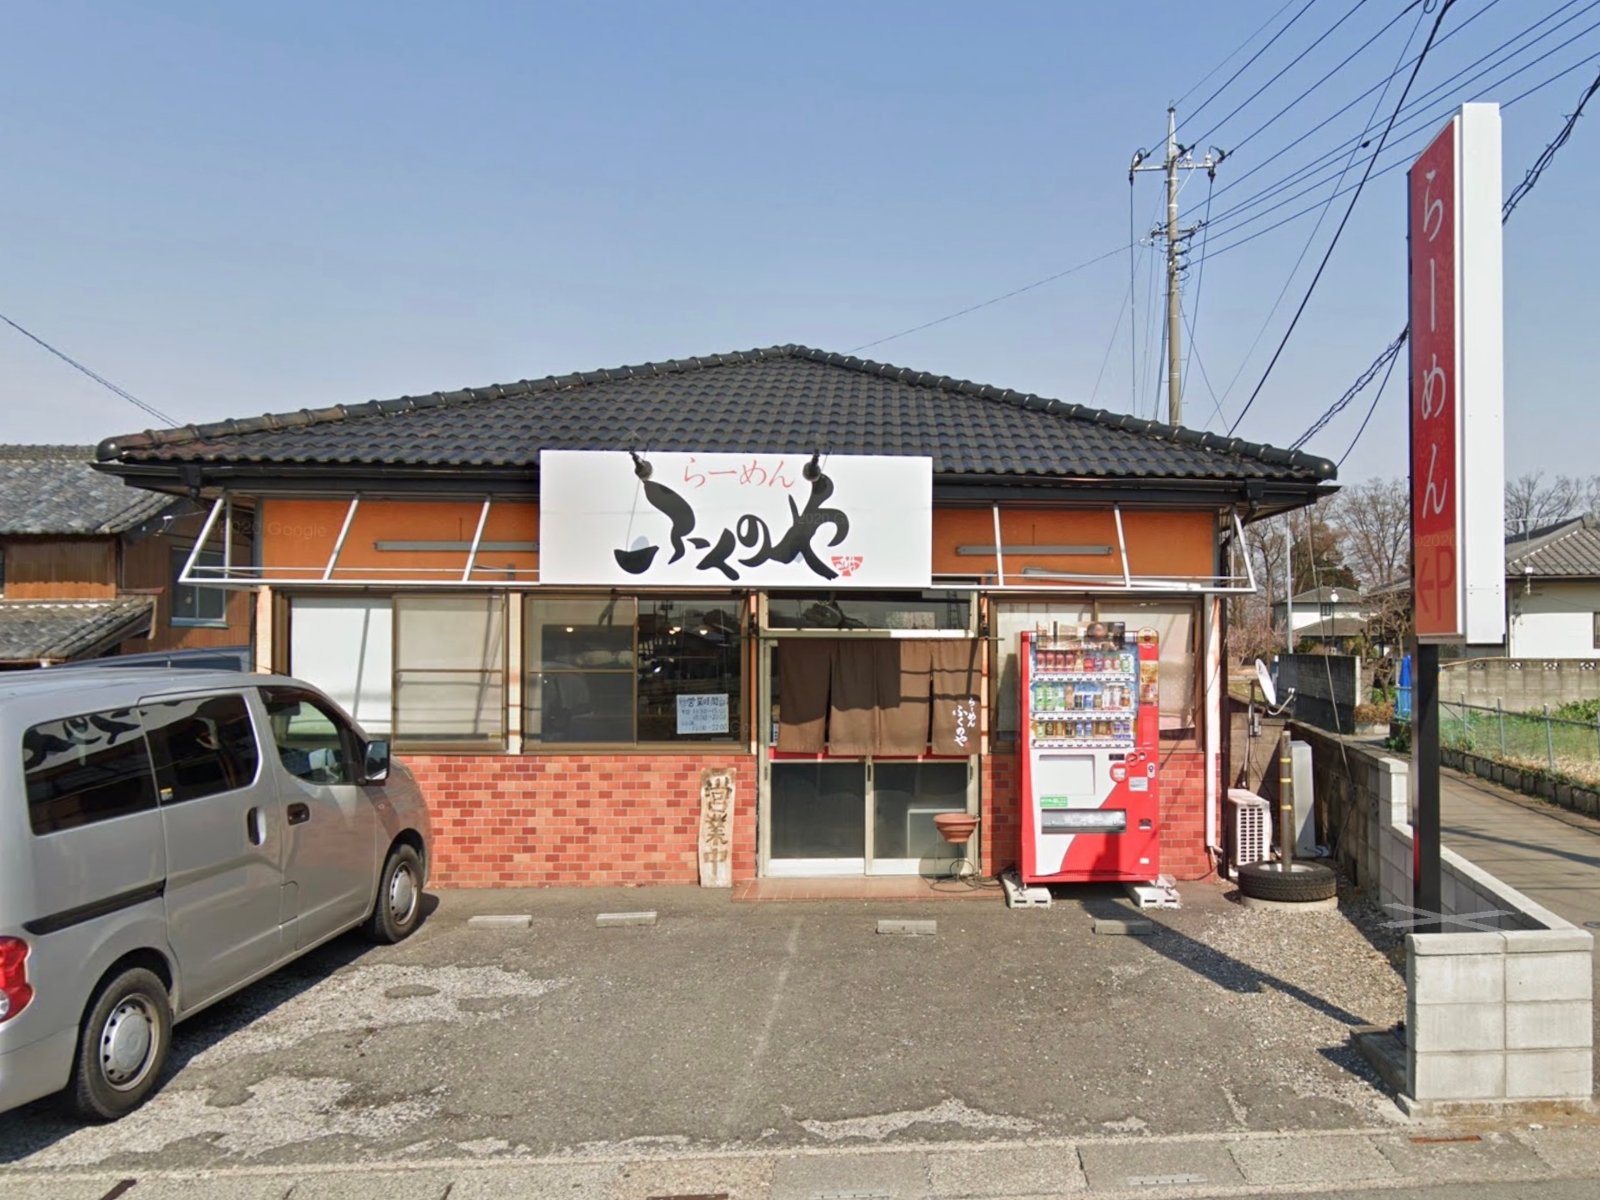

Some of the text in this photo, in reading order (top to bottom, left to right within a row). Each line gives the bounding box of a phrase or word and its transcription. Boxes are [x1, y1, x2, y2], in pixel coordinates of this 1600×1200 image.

[1420, 168, 1448, 520] らーめん
[683, 457, 795, 489] らーめん
[614, 472, 850, 581] ふくのや
[952, 704, 968, 747] ふくのや
[967, 697, 977, 728] らーめん
